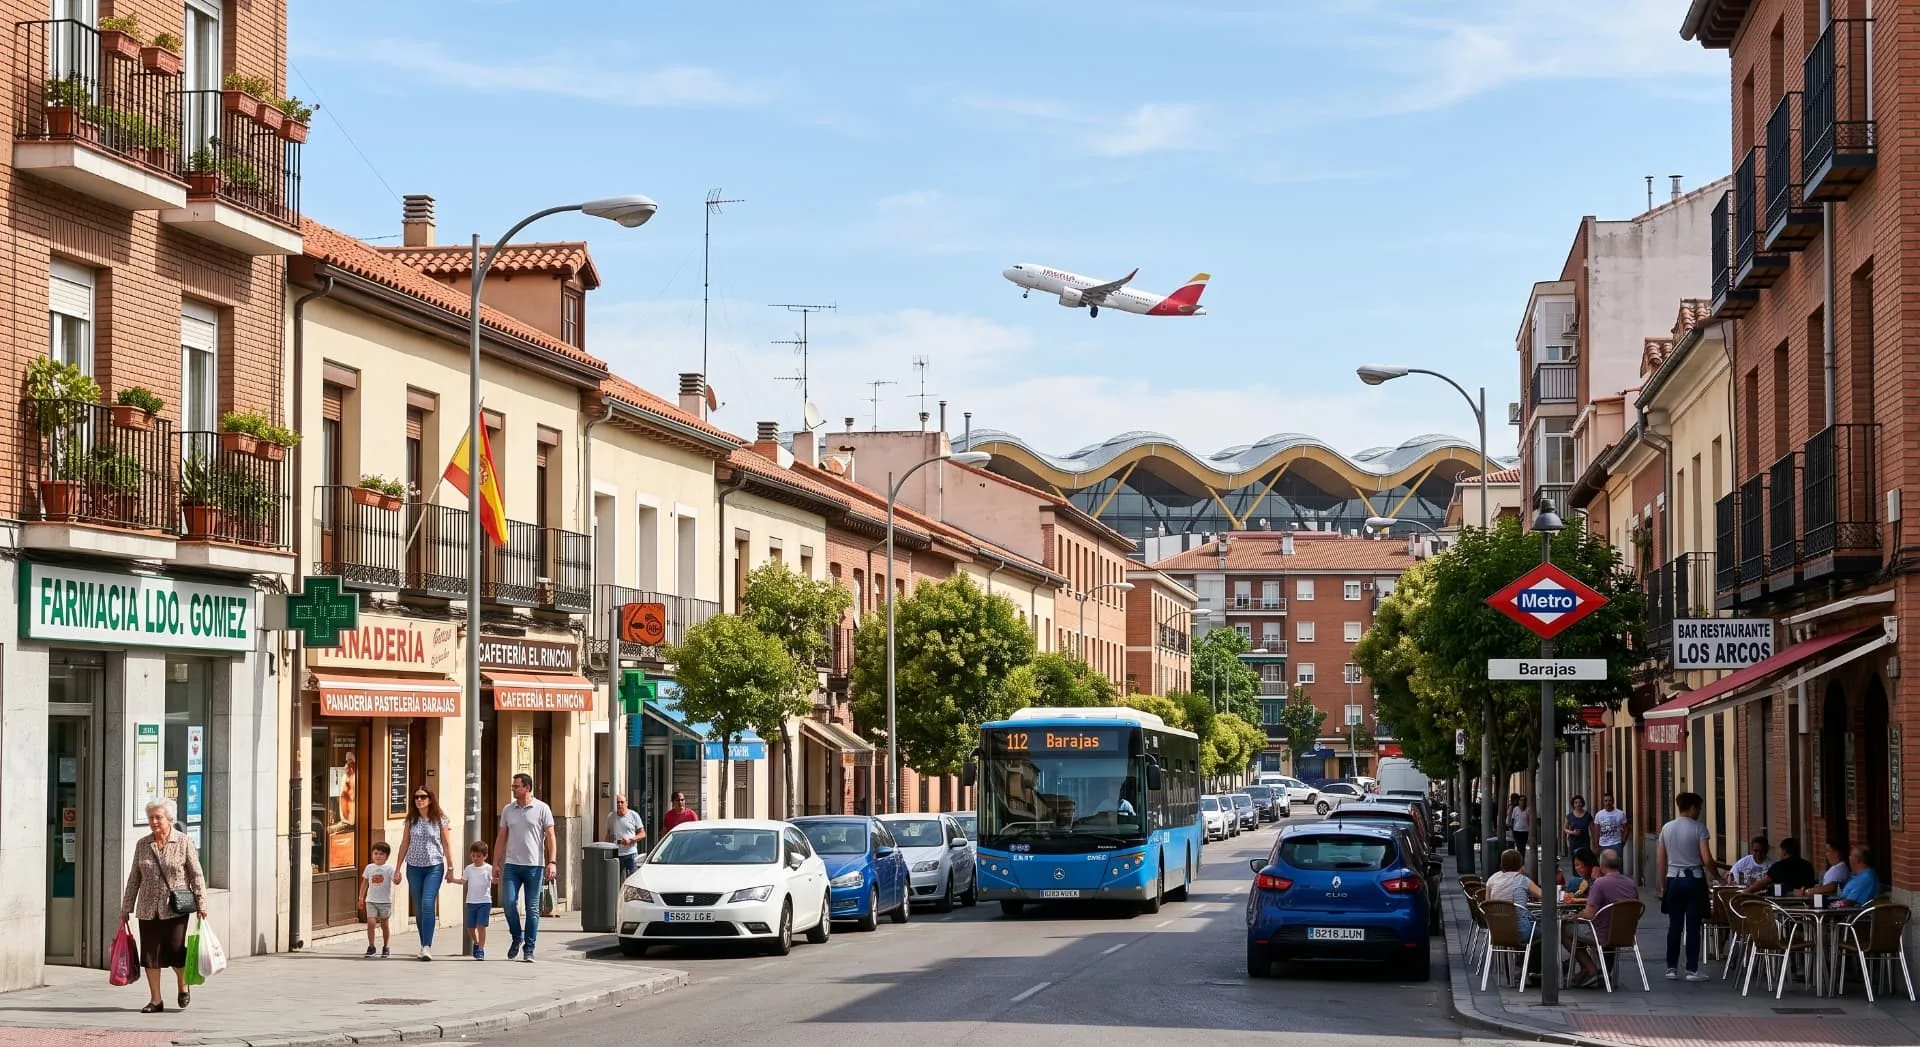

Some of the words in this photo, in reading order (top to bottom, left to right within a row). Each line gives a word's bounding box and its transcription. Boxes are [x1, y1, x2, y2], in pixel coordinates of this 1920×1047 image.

[41, 577, 139, 631] FARMACIA
[145, 588, 184, 635] LDO.
[190, 592, 247, 639] GOMEZ
[1522, 593, 1573, 608] Metro
[1678, 623, 1698, 638] BAR
[1700, 623, 1770, 638] RESTAURANTE
[479, 641, 527, 665] CAFETERÍA
[528, 647, 539, 666] EL
[541, 646, 572, 668] RINCÓN
[1678, 642, 1710, 664] LOS
[1715, 642, 1771, 663] ARCOS
[1519, 663, 1577, 678] Barajas
[326, 692, 373, 711] PANADERÍA
[374, 692, 421, 712] PASTELERÍA
[422, 696, 456, 713] BARAJAS
[501, 688, 543, 708] CAFETERÍA
[545, 693, 555, 708] EL
[556, 691, 585, 709] RINCÓN
[1007, 733, 1028, 750] 112
[1046, 732, 1100, 750] Barajas
